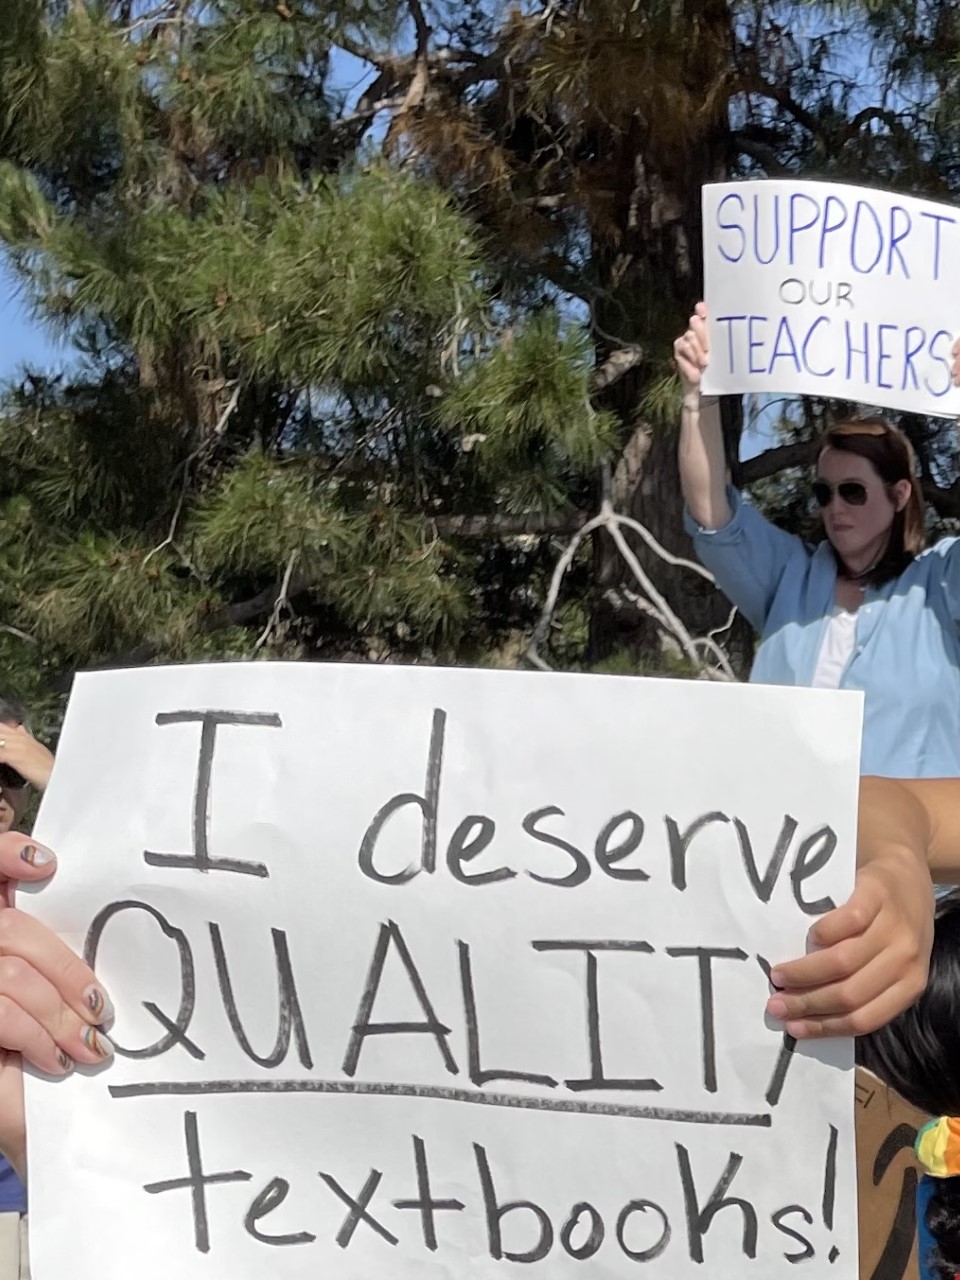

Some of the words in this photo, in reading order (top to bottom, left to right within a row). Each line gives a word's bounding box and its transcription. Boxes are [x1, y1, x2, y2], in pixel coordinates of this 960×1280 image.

[716, 193, 957, 281] SUPPORT
[778, 278, 855, 308] OUR
[716, 315, 954, 398] TEACHERS
[143, 709, 283, 878] I
[358, 707, 838, 915] deserve
[143, 1110, 839, 1265] textbooks!
